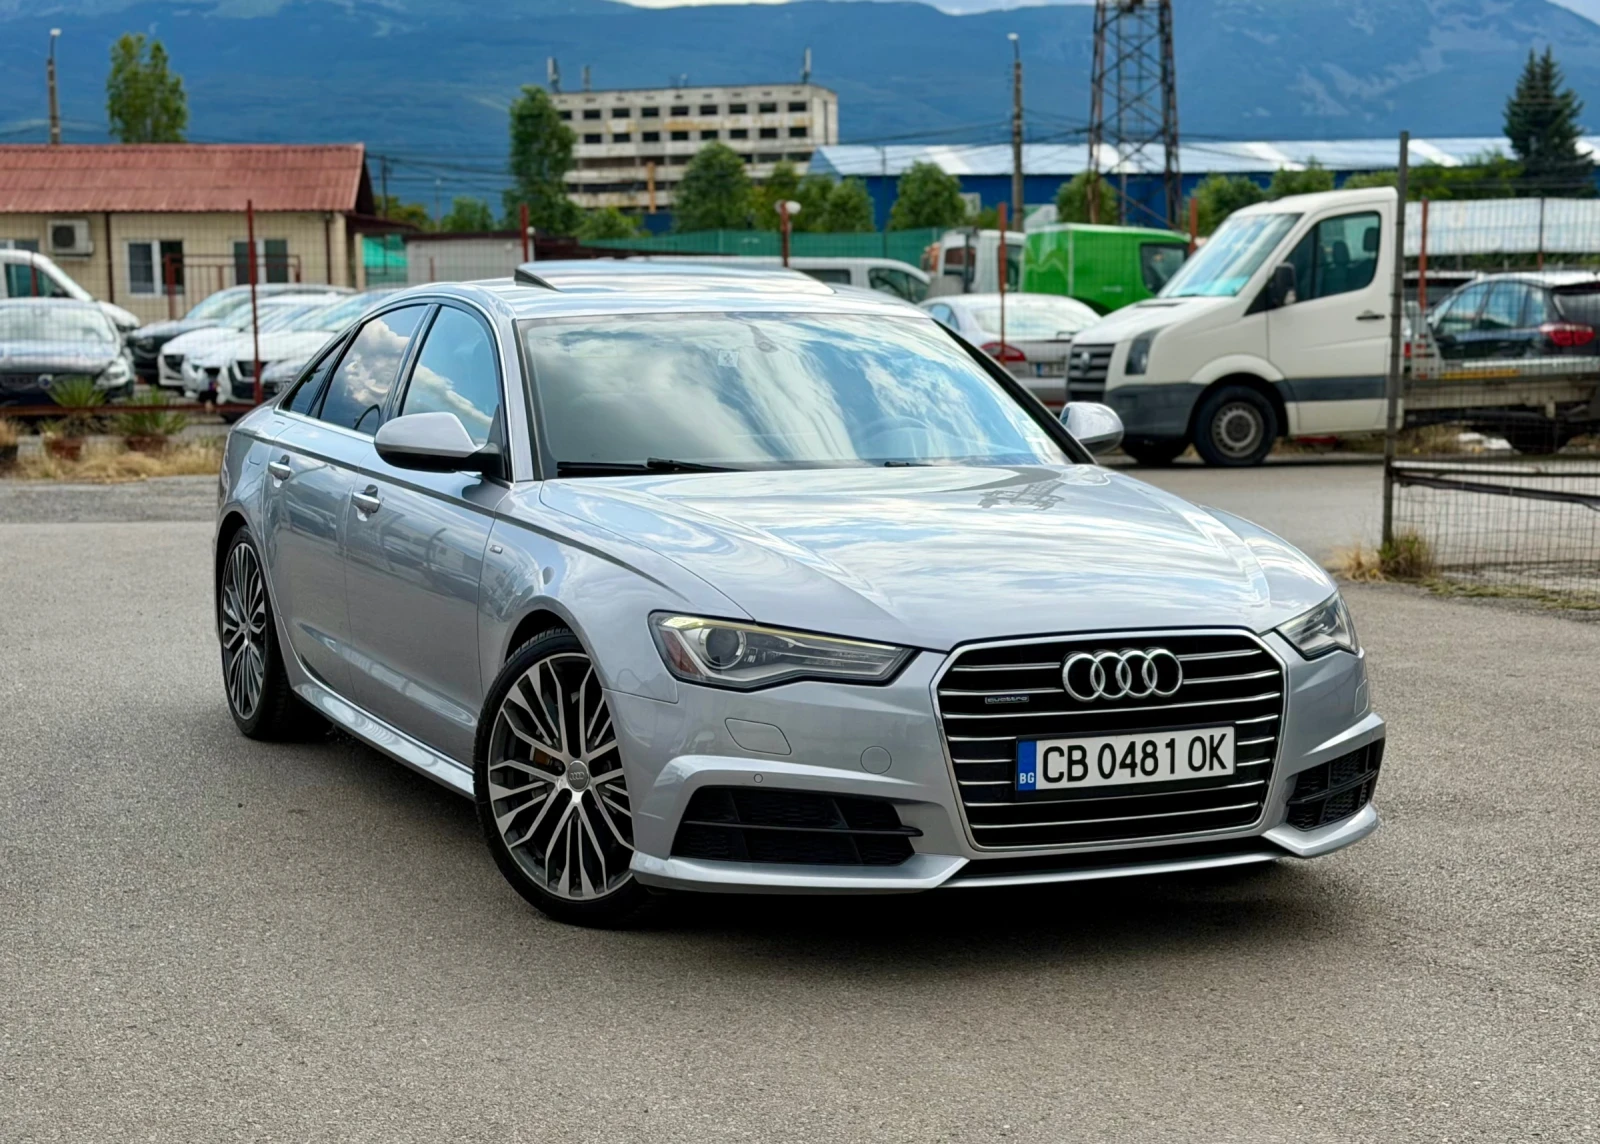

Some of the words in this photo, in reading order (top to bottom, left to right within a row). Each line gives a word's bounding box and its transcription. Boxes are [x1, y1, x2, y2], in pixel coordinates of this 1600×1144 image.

[1042, 745, 1089, 783] CB
[1097, 738, 1176, 780] 0481
[1187, 733, 1228, 773] OK
[1019, 772, 1035, 784] BG
